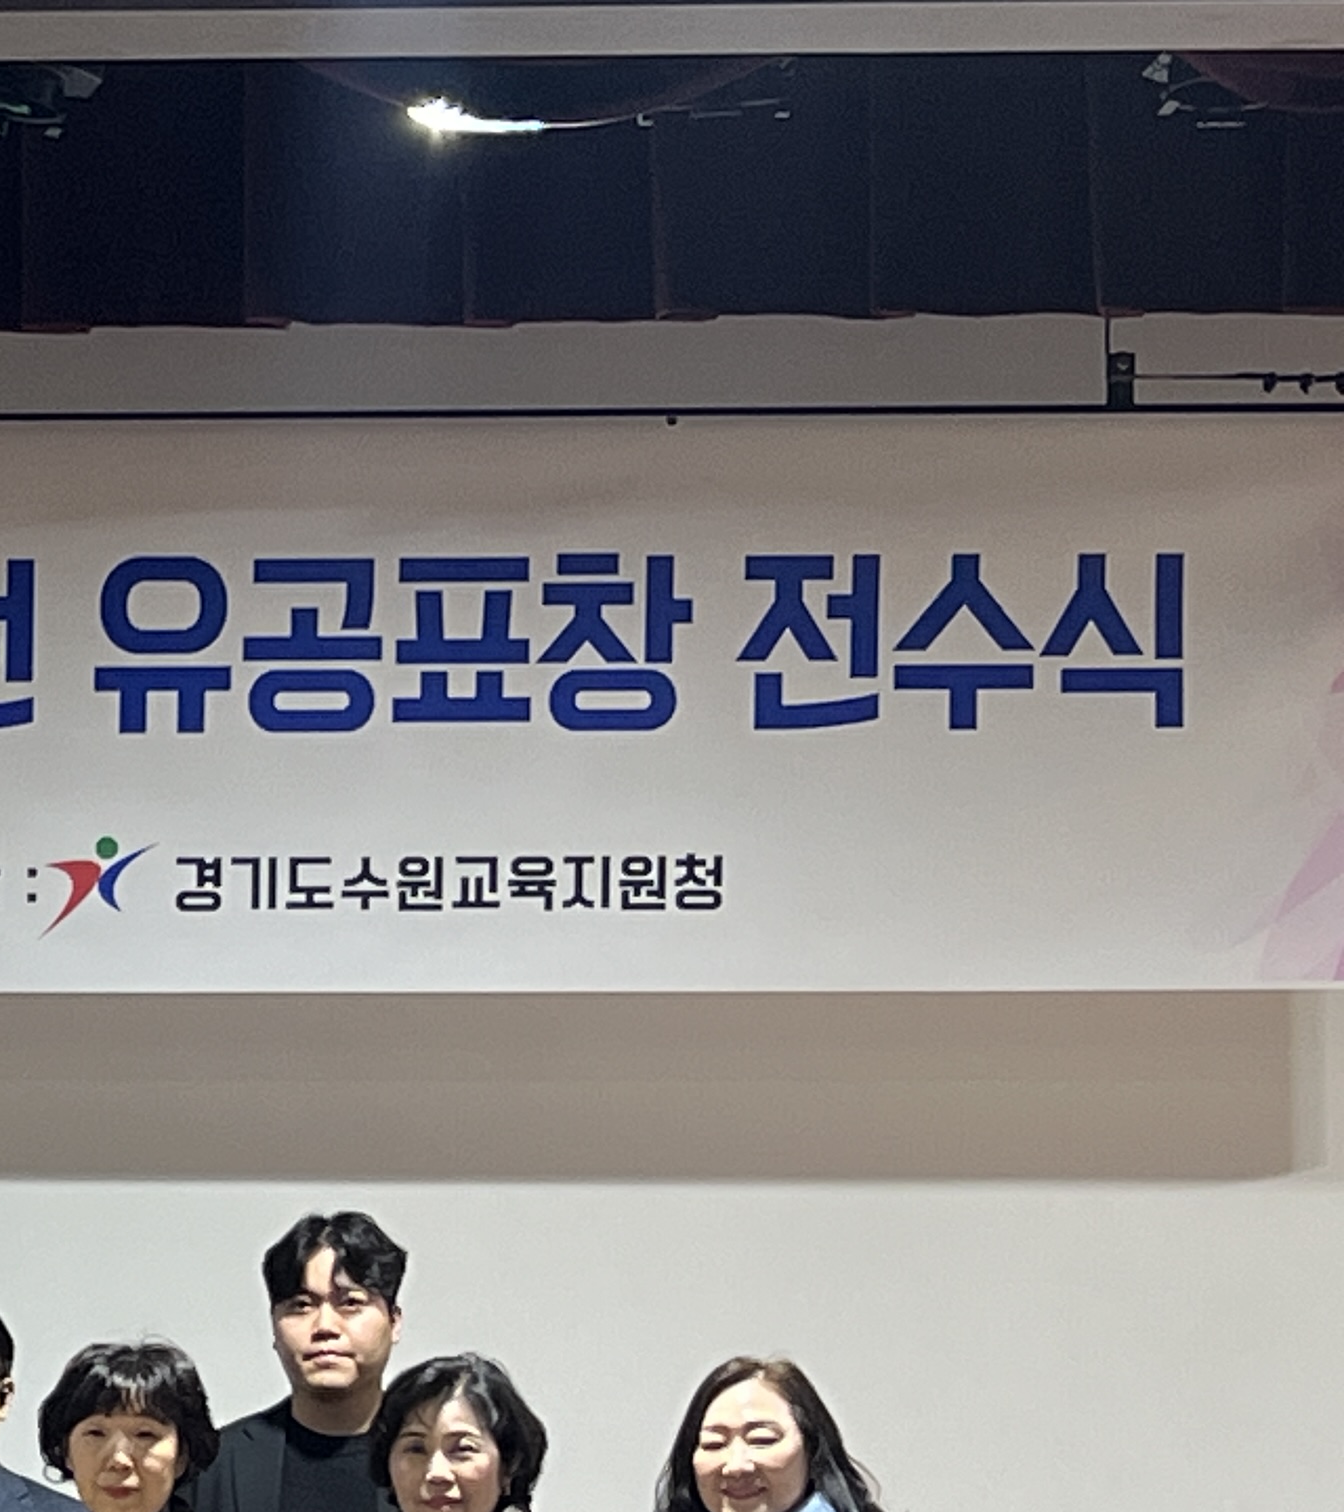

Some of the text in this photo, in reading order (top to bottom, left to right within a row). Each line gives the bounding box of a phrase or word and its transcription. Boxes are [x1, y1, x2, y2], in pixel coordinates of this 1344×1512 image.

[92, 552, 695, 735] 유공표창
[737, 552, 1186, 731] 전수식
[26, 867, 38, 903] :
[175, 854, 724, 912] 경기도수원교육지원청
